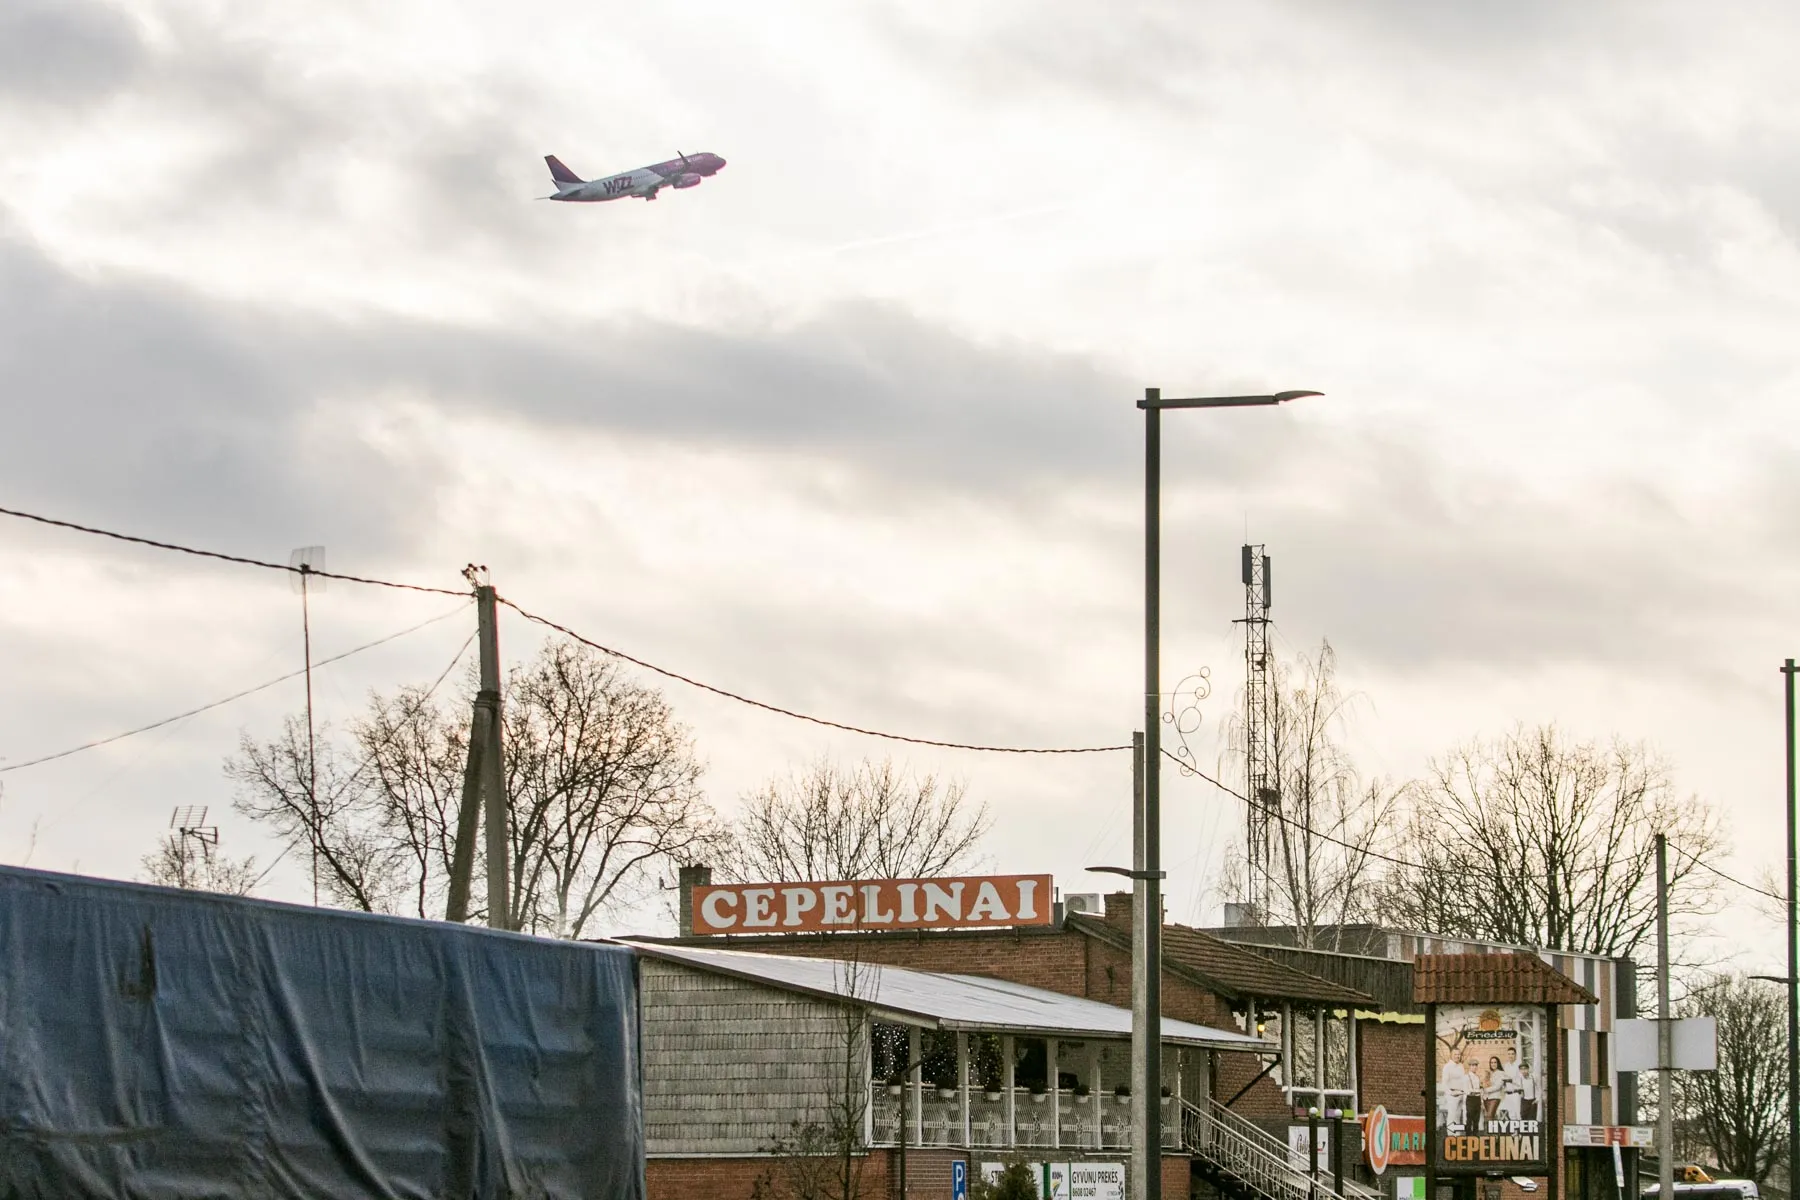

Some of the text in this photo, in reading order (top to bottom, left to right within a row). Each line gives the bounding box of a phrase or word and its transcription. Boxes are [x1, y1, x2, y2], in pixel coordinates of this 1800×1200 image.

[701, 879, 1038, 929] CEPELINAI
[1488, 1120, 1539, 1134] HYPER
[1444, 1135, 1540, 1161] CEPELINAI
[955, 1164, 964, 1191] P
